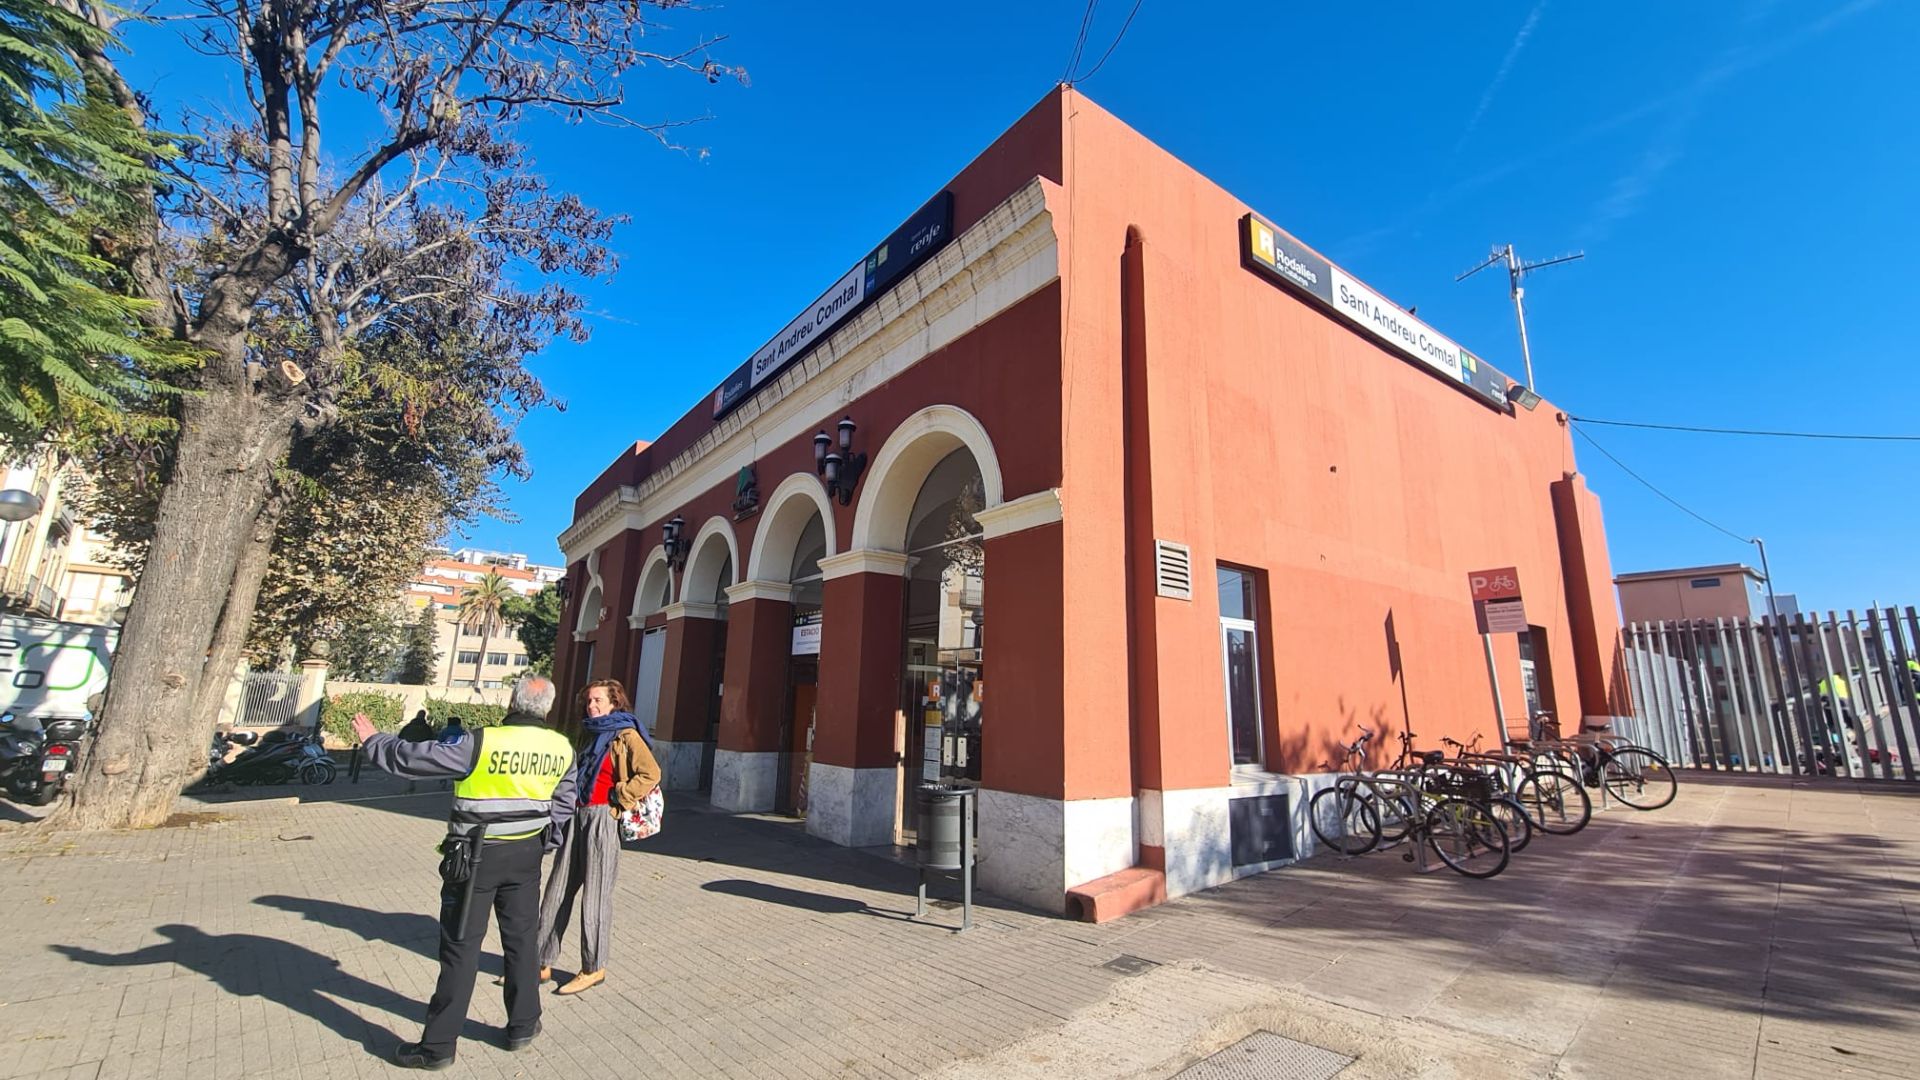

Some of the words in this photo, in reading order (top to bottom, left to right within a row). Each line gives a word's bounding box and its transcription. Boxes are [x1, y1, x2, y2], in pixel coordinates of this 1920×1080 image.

[910, 224, 940, 254] renfe
[1259, 227, 1275, 258] R
[1276, 247, 1317, 284] Rodalies
[756, 349, 776, 376] Sant
[778, 321, 814, 358] Andreu
[816, 277, 858, 326] Comtal
[1340, 284, 1370, 318] Sant
[1373, 306, 1417, 345] Andreu
[1419, 334, 1457, 369] Comtal
[1471, 576, 1488, 595] P
[932, 684, 941, 697] R
[488, 750, 565, 778] SEGURIDAD
